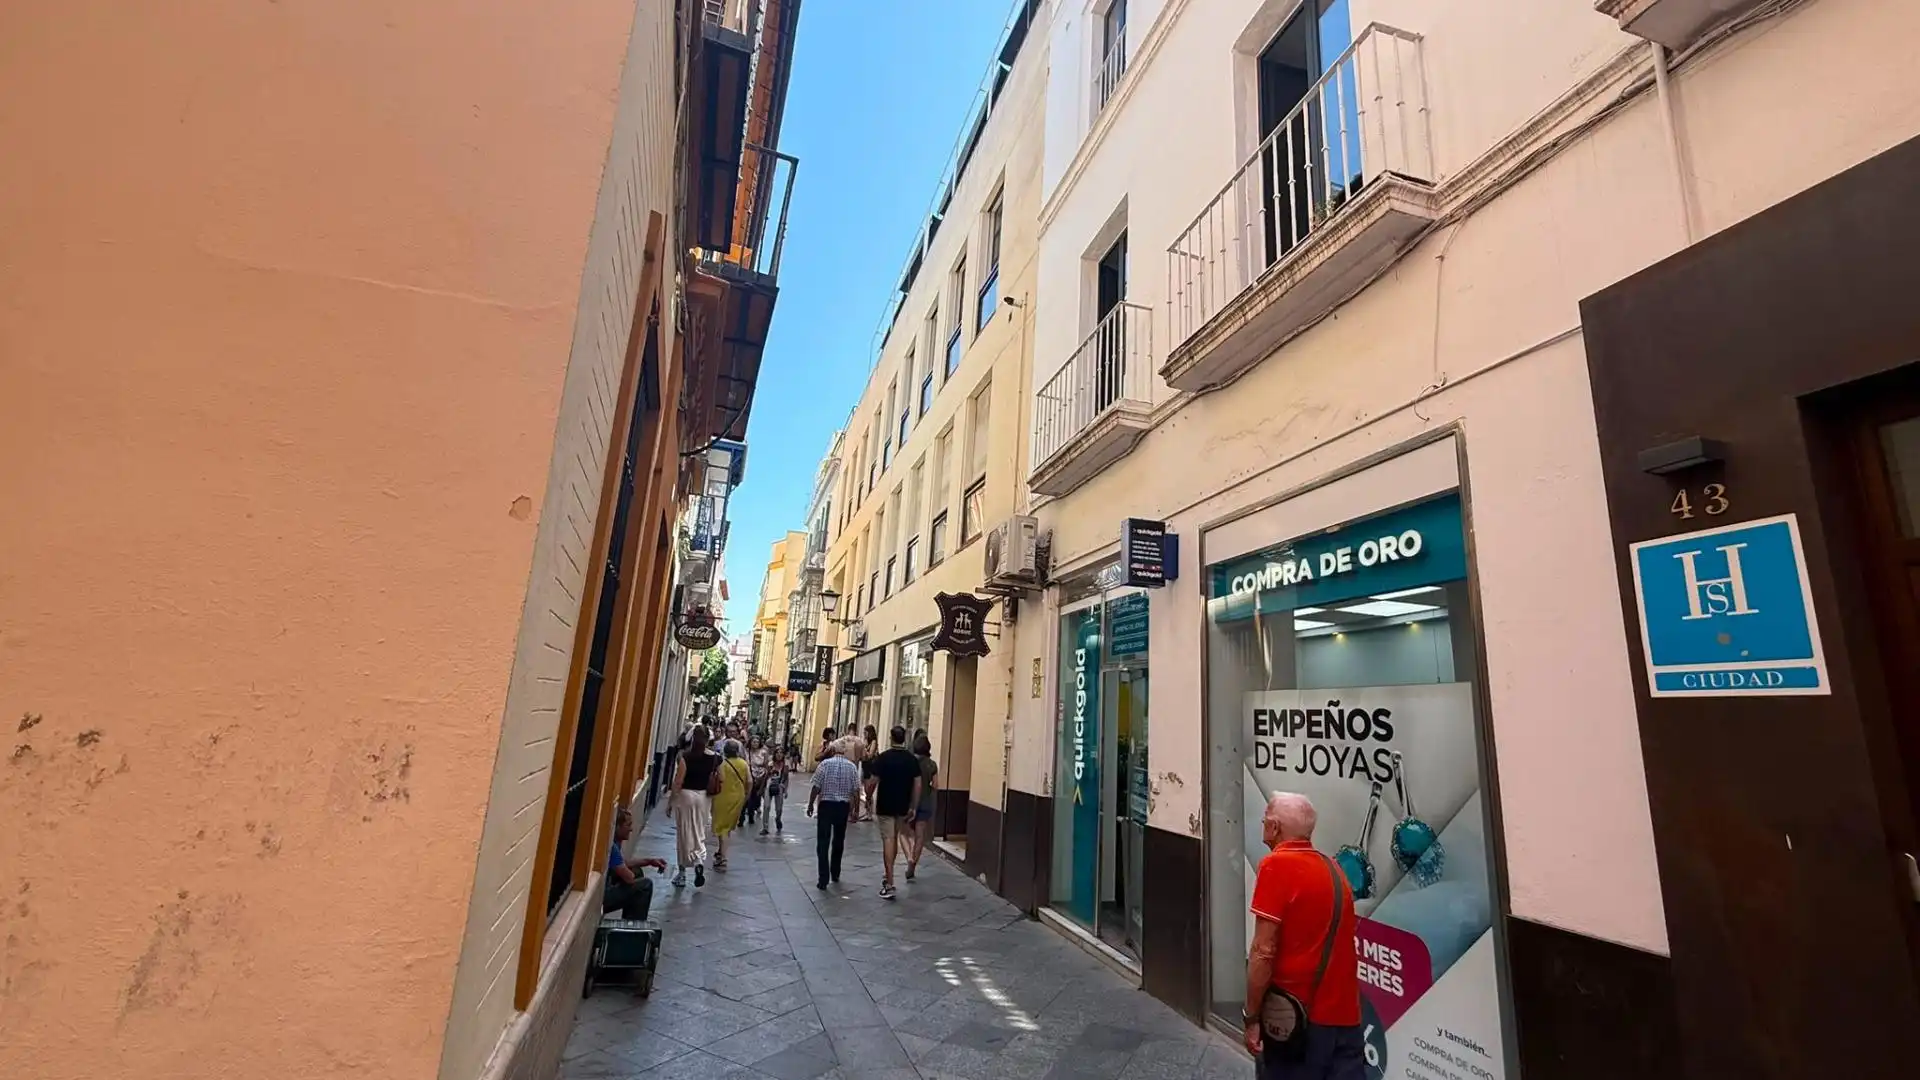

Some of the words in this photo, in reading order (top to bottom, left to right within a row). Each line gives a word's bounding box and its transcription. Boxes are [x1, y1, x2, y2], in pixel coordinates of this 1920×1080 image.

[1671, 483, 1729, 519] 43
[1231, 558, 1313, 596] COMPRA
[1319, 546, 1353, 577] DE
[1358, 529, 1422, 567] ORO
[1682, 670, 1784, 689] CIUDAD
[1073, 648, 1087, 781] quickgold
[1253, 699, 1394, 742] EMPEÑOS
[1255, 741, 1288, 772] DE
[1294, 743, 1394, 784] JOYAS
[1363, 938, 1403, 972] MES
[1436, 1026, 1443, 1037] y
[1408, 1052, 1448, 1080] COMPRA
[1413, 1037, 1454, 1065] COMPRA
[1455, 1056, 1469, 1072] DE
